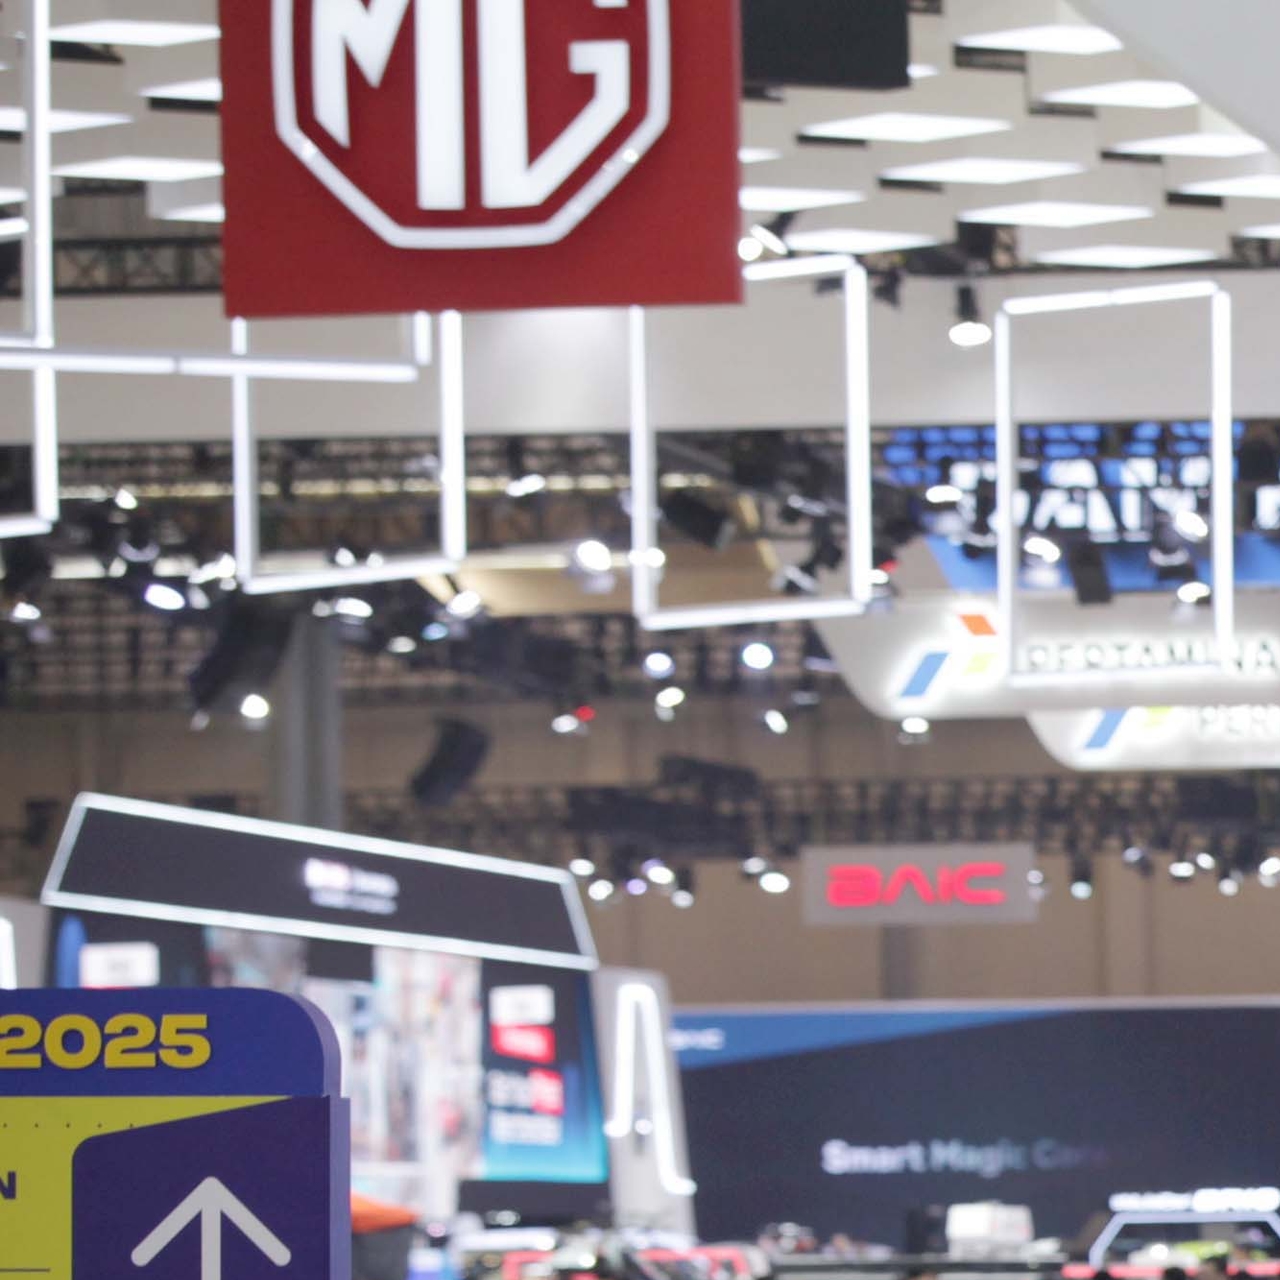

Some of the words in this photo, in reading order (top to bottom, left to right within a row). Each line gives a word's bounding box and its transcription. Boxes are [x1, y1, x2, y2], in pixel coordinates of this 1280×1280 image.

[311, 0, 630, 210] MG
[827, 864, 1007, 907] BAIC
[0, 1013, 211, 1069] 2025
[821, 1139, 925, 1175] Smart
